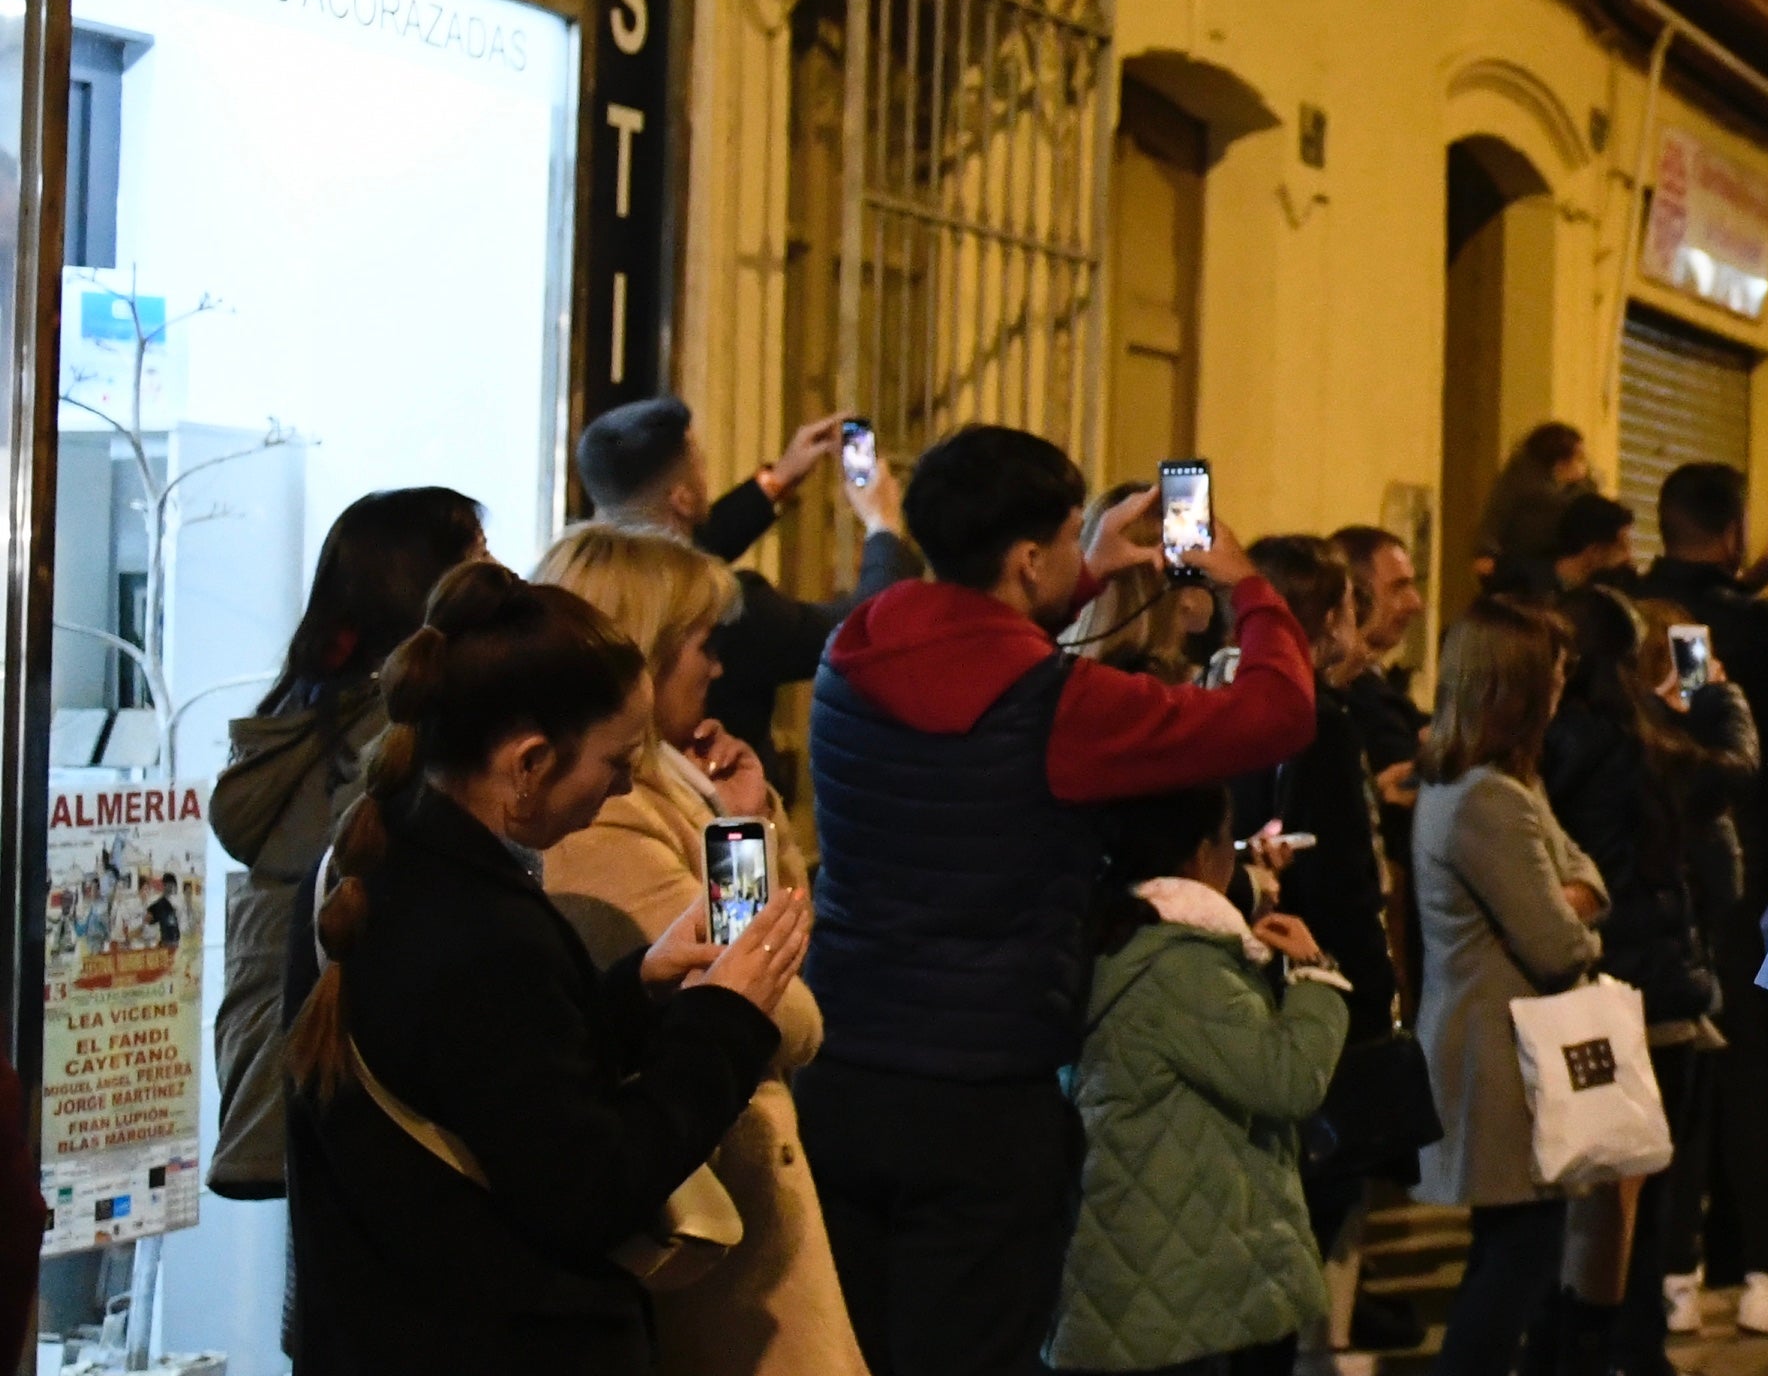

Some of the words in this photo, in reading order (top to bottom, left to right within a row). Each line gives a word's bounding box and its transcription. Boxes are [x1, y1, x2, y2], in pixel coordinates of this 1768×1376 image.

[50, 782, 202, 830] ALMERÍA
[67, 1012, 104, 1031] LEA
[110, 1002, 179, 1025] VICENS
[76, 1038, 101, 1055] EL
[109, 1027, 169, 1049] FANDI
[65, 1045, 178, 1077] CAYETANO
[53, 1092, 107, 1117] JORGE
